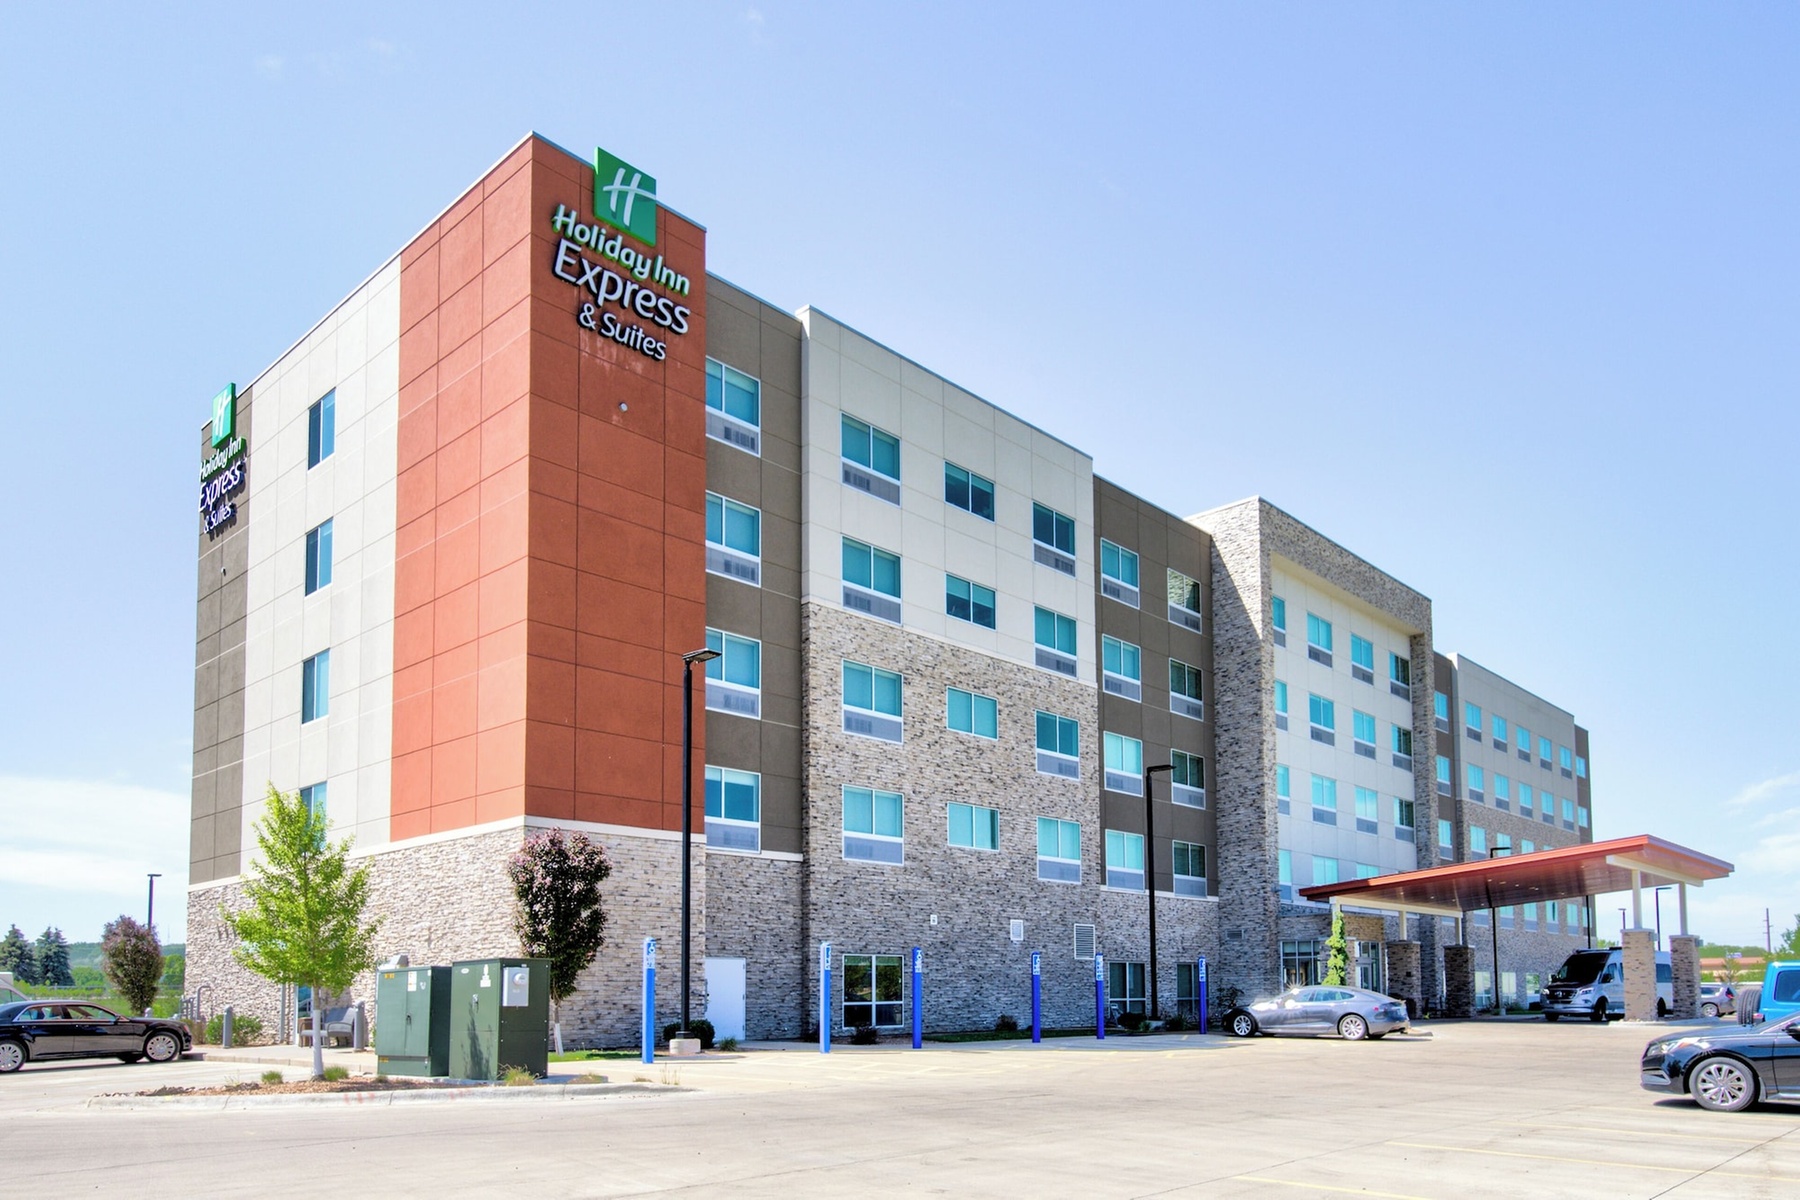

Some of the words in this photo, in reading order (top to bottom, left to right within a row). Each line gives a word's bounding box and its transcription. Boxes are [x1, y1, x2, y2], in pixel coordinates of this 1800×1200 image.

[552, 203, 652, 282] Holiday
[653, 254, 691, 297] Inn
[553, 238, 691, 335] Express
[578, 302, 597, 332] &
[600, 312, 667, 361] Suites
[199, 448, 229, 480] Holiday
[228, 436, 242, 459] Inn
[198, 460, 241, 513] Express
[209, 502, 232, 530] Suites
